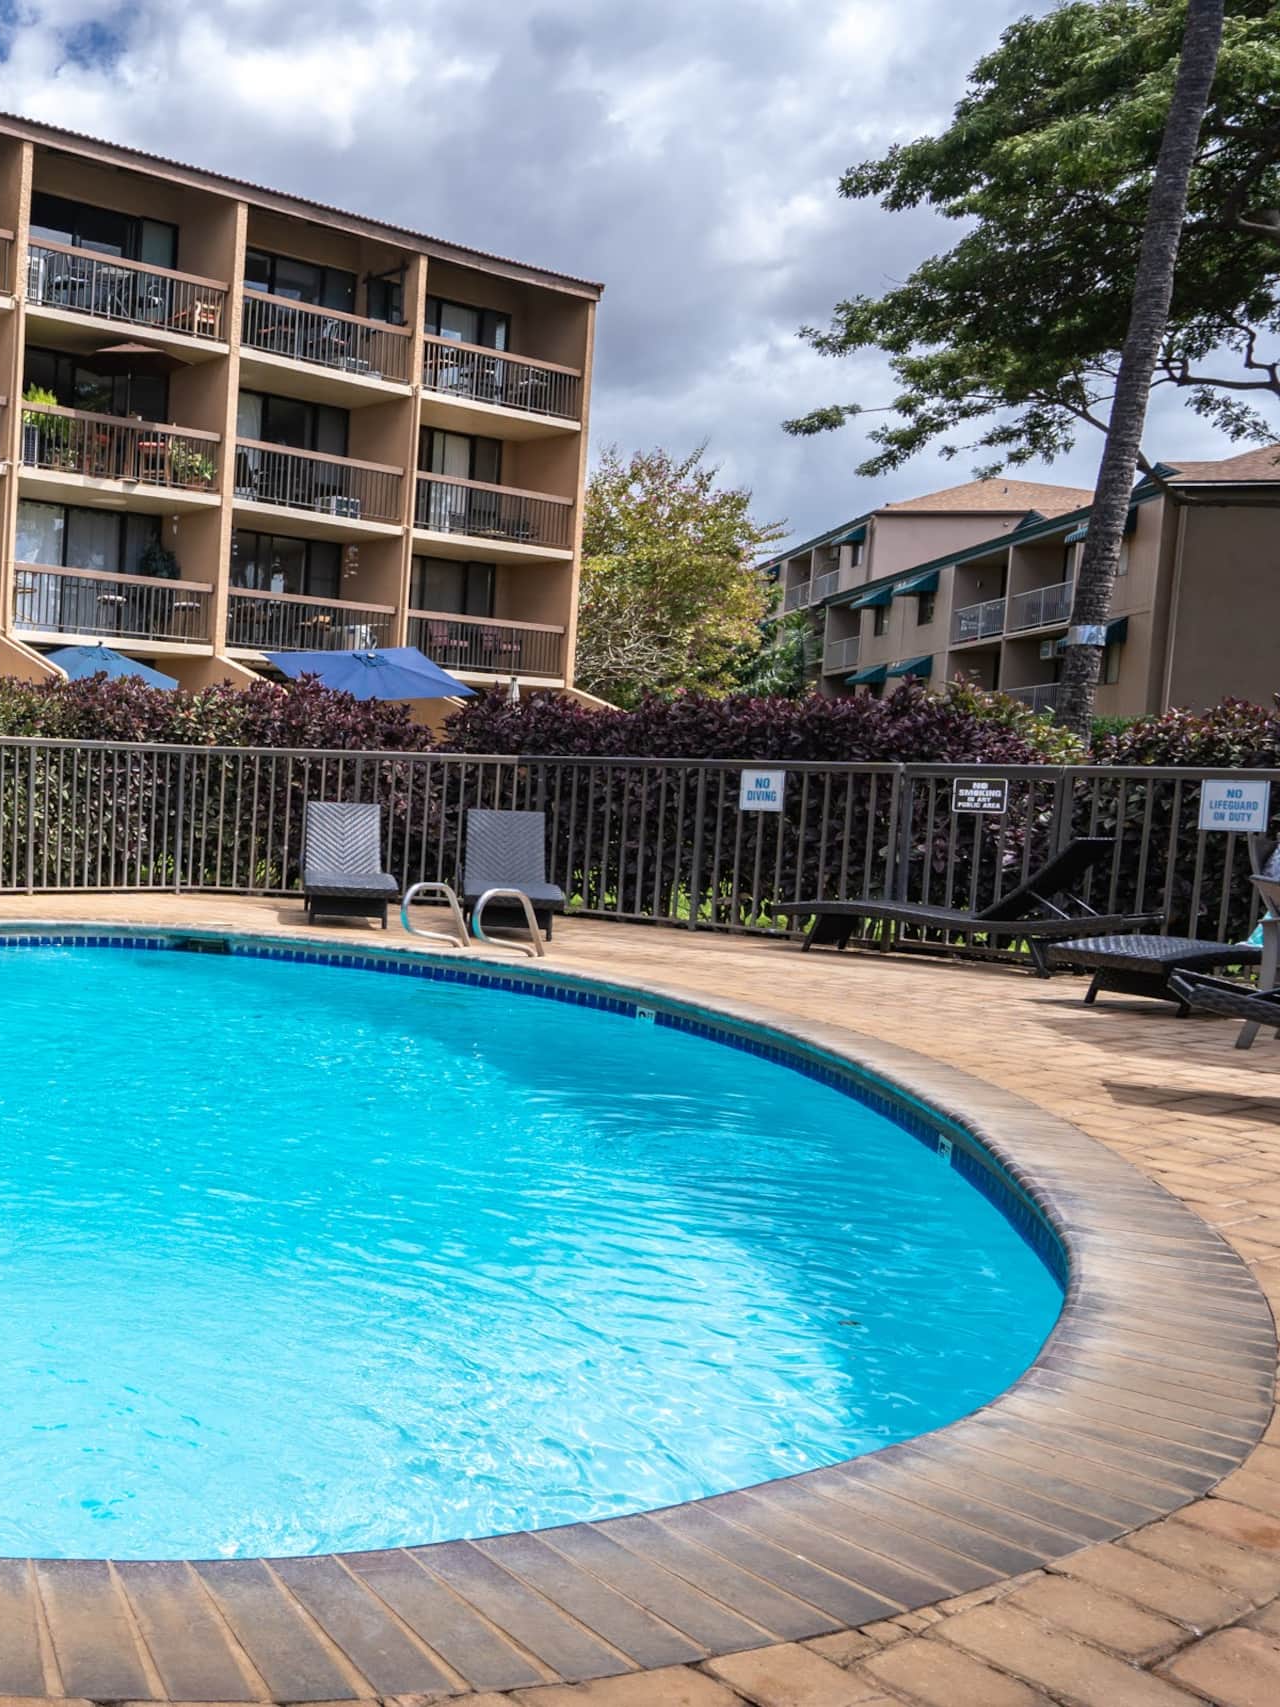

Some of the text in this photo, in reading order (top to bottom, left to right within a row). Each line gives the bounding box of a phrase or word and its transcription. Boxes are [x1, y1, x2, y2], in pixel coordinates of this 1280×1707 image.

[755, 777, 771, 789] NO
[747, 790, 777, 802] DIVING
[958, 789, 1002, 797] SMOKING
[1226, 788, 1243, 799] NO
[1209, 800, 1259, 811] LIFEGUARD
[1214, 811, 1252, 822] ON DUTY
